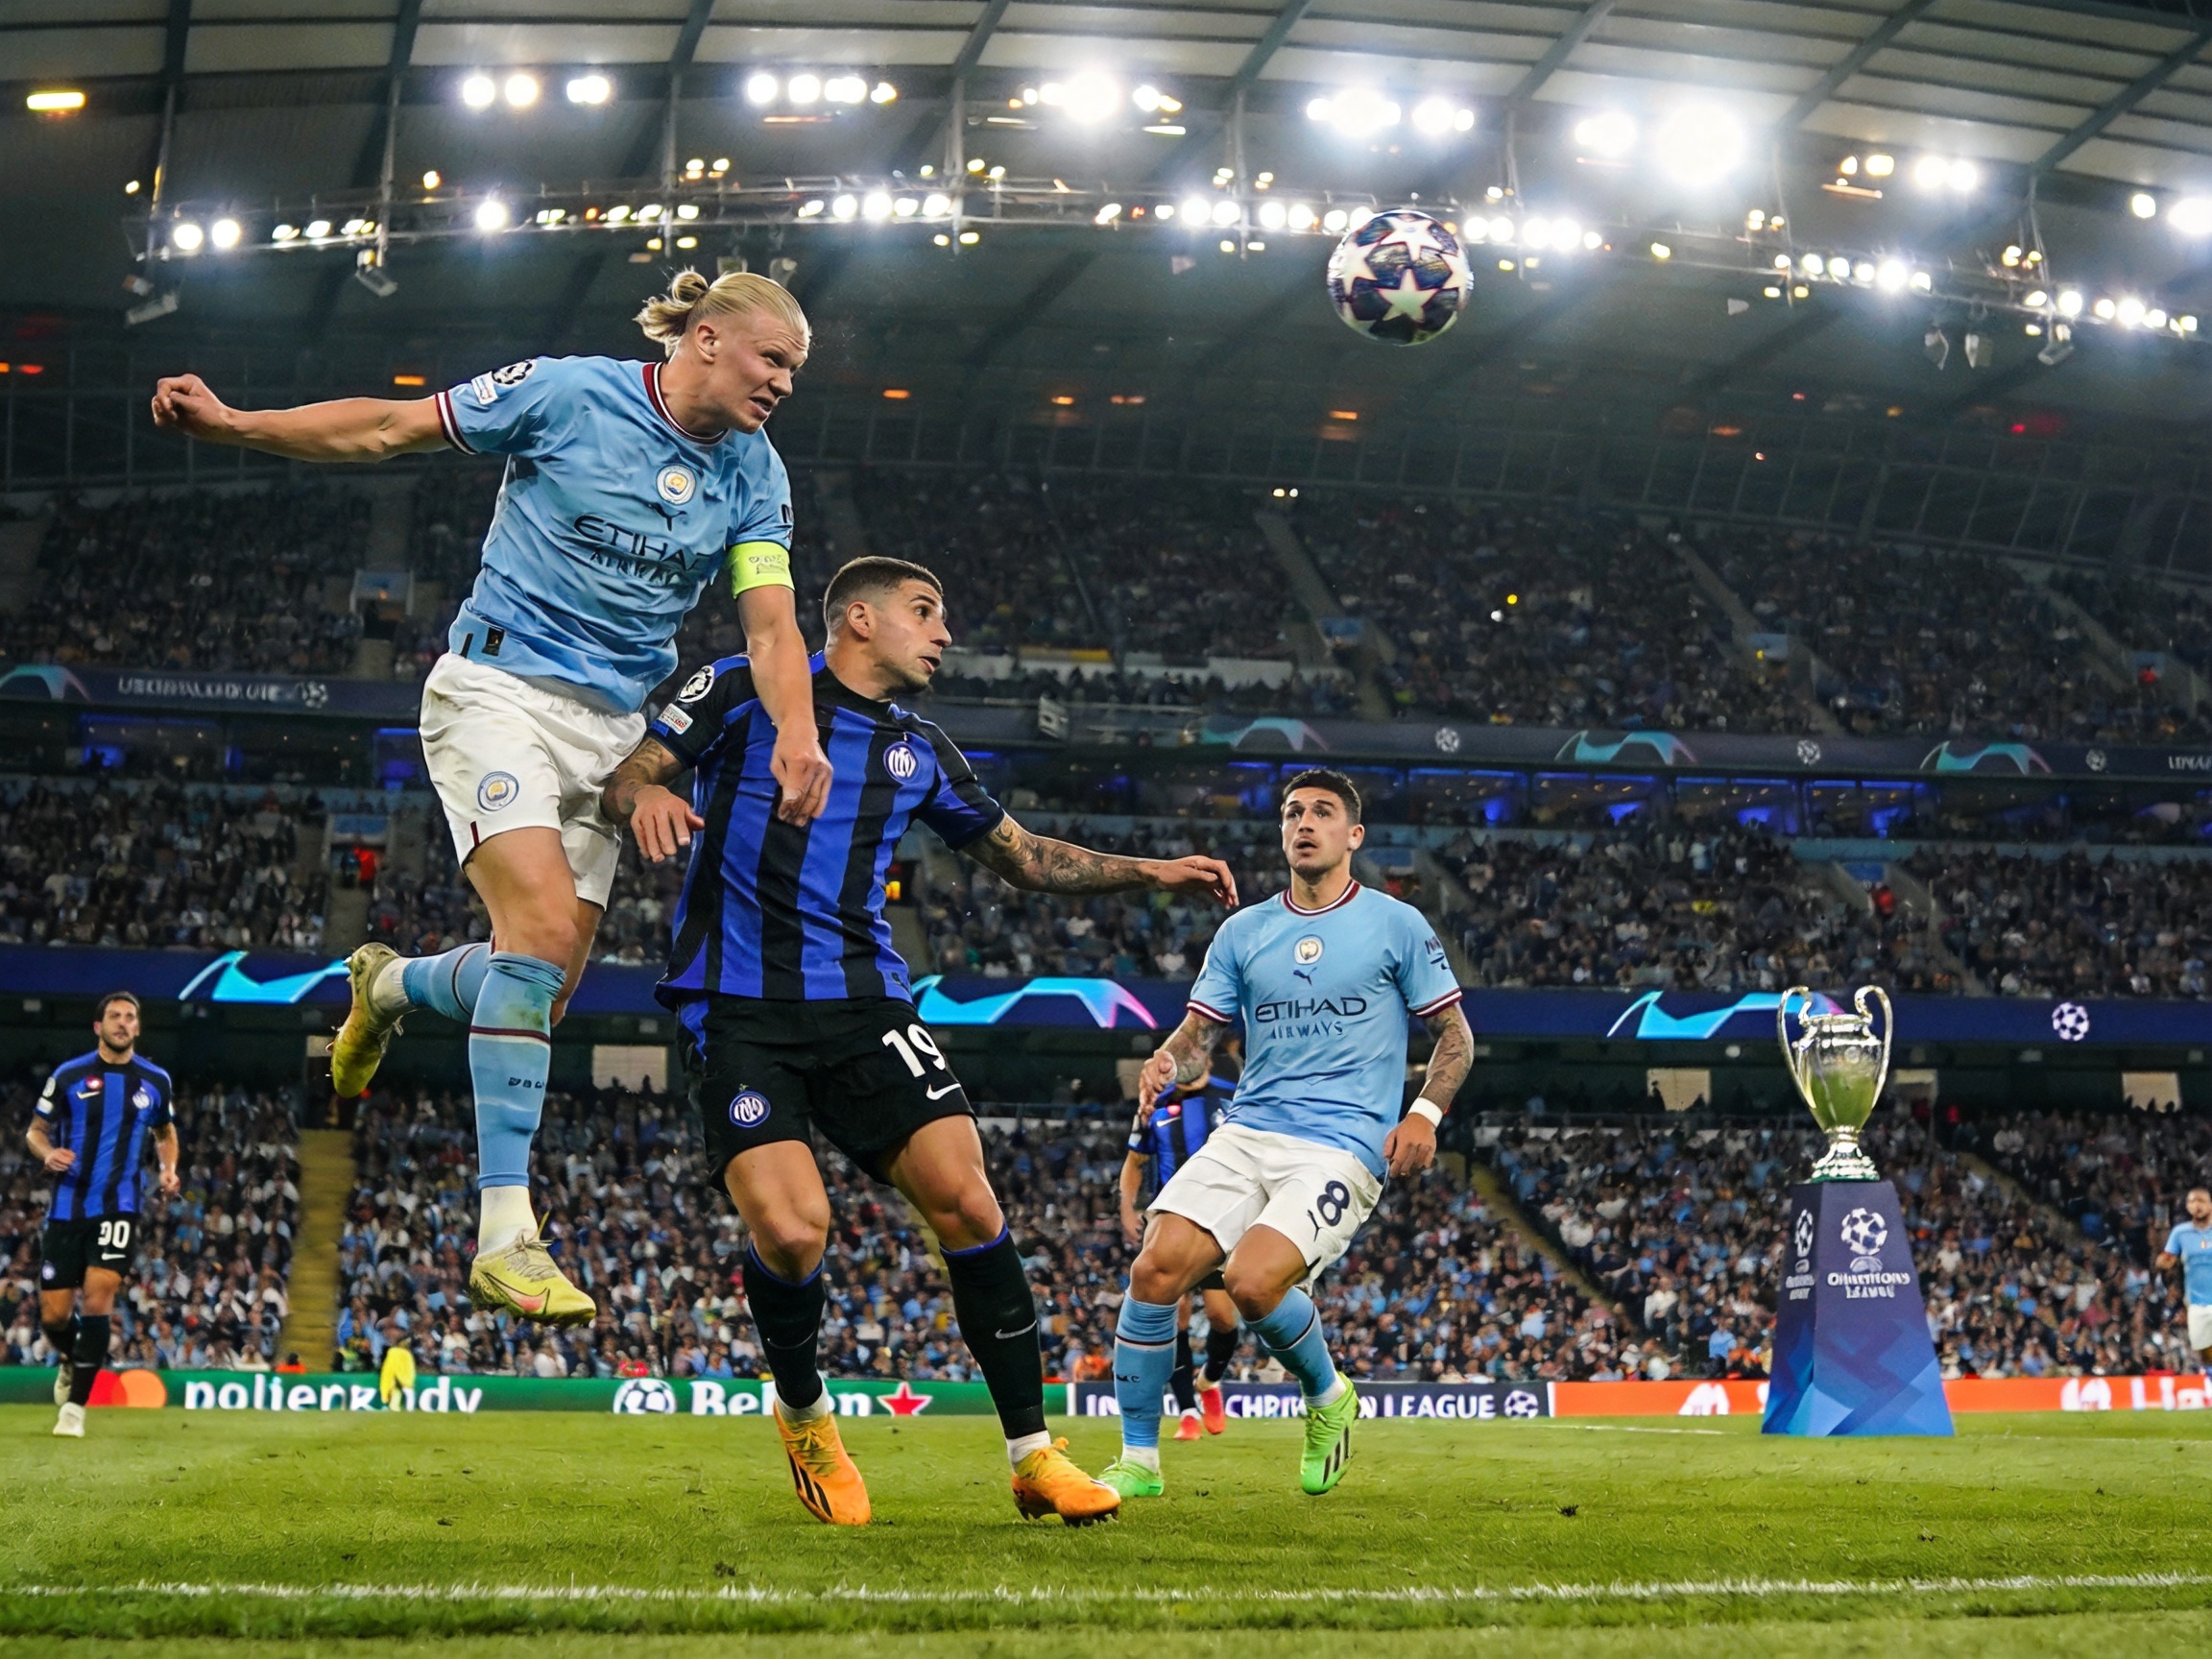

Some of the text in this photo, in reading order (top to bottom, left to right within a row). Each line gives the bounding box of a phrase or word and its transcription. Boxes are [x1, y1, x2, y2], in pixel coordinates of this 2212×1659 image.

[1255, 997, 1367, 1023] ETIHAD
[1268, 1021, 1343, 1040] AIRWAYS
[881, 1023, 946, 1078] 19
[1316, 1180, 1350, 1227] 8
